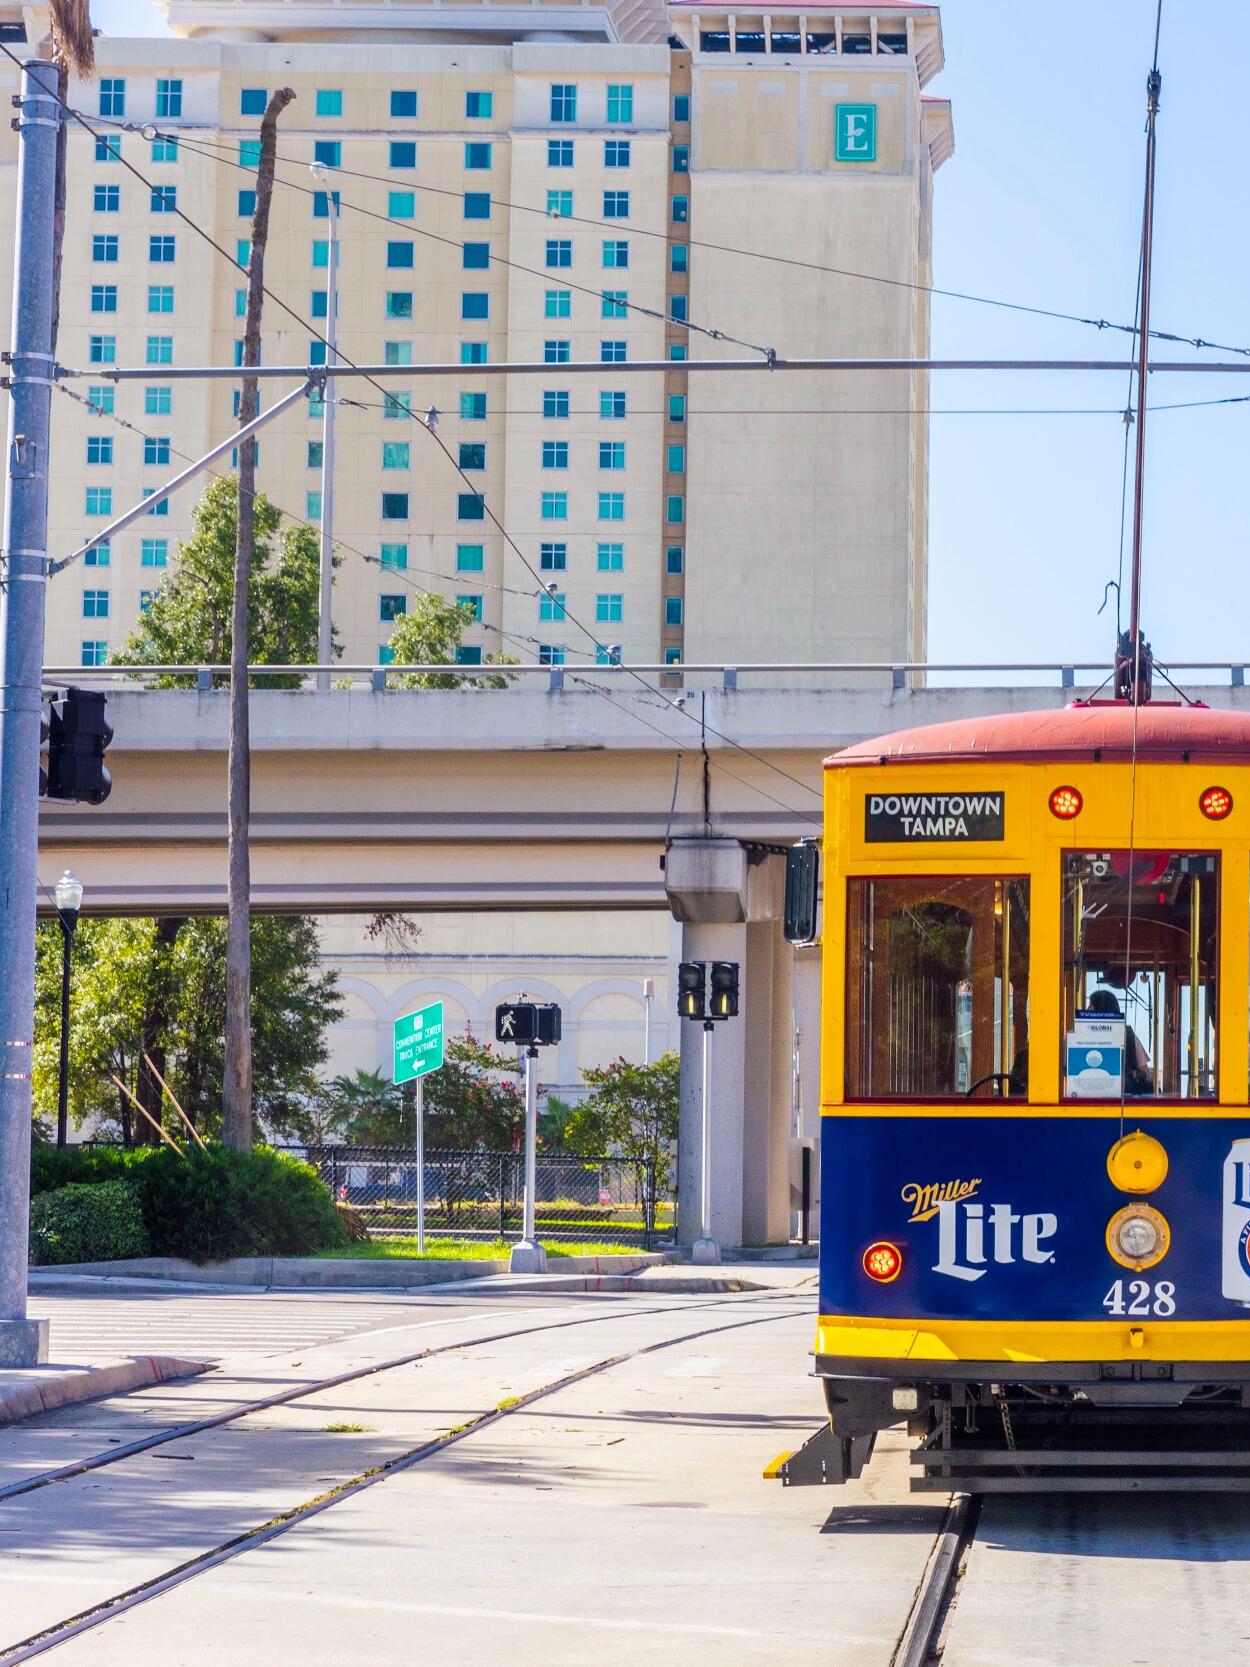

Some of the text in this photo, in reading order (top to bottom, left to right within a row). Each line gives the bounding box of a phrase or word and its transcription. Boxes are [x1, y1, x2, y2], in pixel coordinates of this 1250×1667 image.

[844, 114, 868, 151] E
[870, 796, 1000, 815] DOWNTOWN
[900, 817, 968, 836] TAMPA
[901, 1178, 982, 1222] Miller
[932, 1200, 1058, 1282] Lite
[1103, 1280, 1176, 1316] 428
